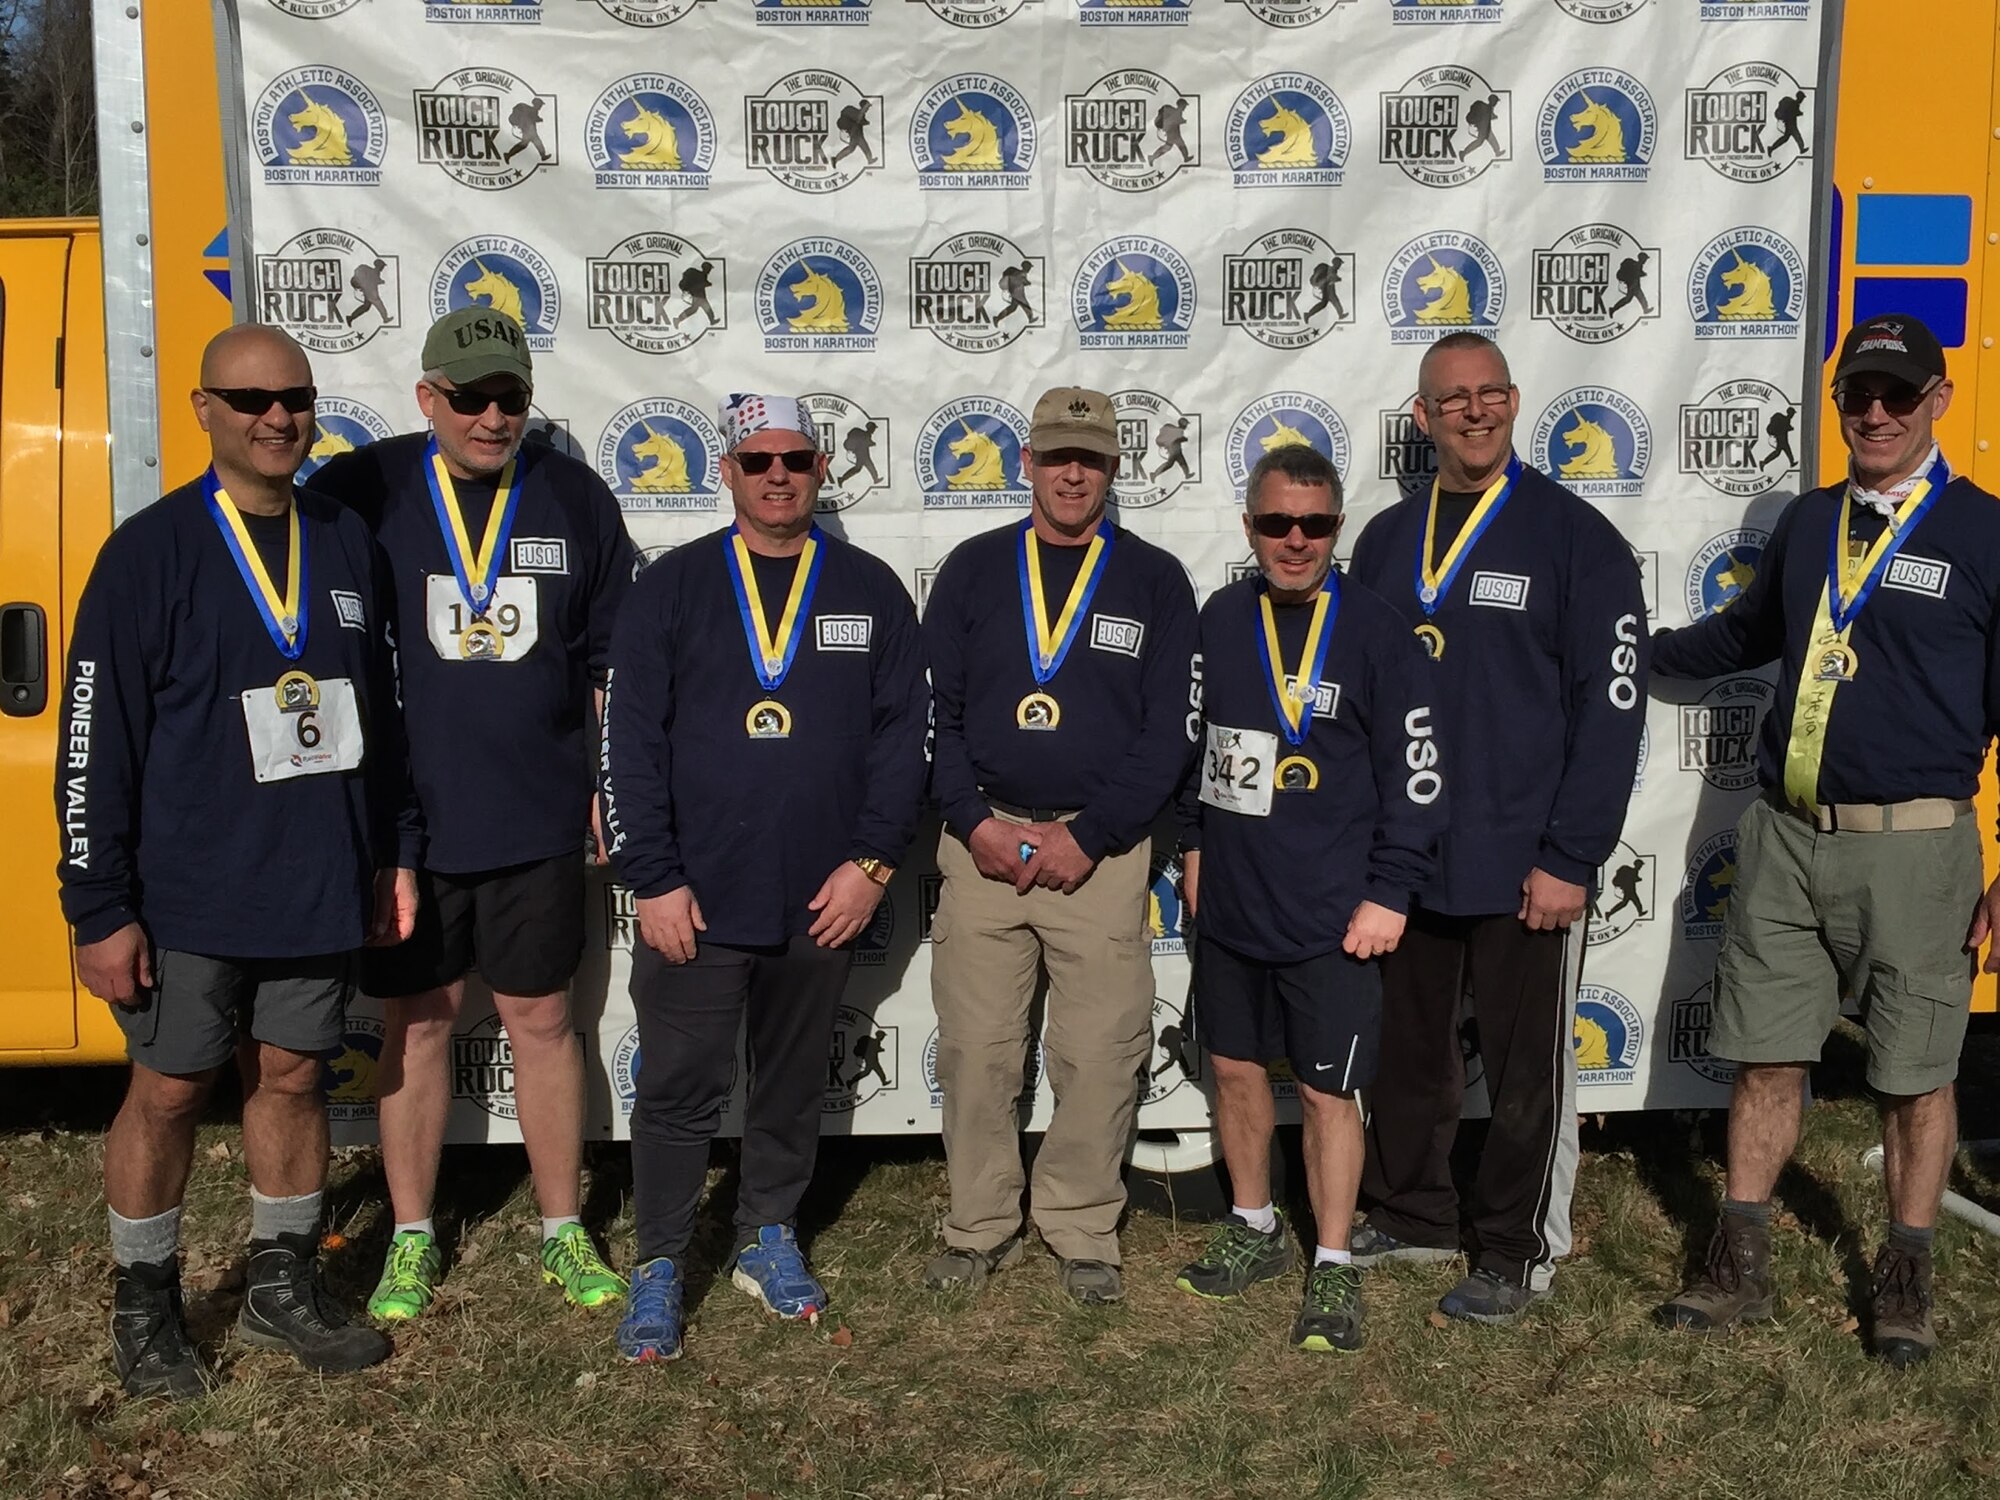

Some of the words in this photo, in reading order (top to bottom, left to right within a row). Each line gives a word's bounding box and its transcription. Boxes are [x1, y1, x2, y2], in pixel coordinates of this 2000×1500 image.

[290, 4, 319, 14] RUCK
[322, 4, 336, 14] ON
[426, 7, 471, 19] BOSTON
[476, 8, 541, 20] MARATHON
[757, 11, 801, 21] BOSTON
[806, 11, 869, 21] MARATHON
[1081, 11, 1124, 22] BOSTON
[1128, 11, 1189, 22] MARATHON
[1269, 14, 1296, 24] RUCK
[1299, 13, 1311, 23] ON
[1393, 10, 1436, 20] BOSTON
[1441, 9, 1501, 20] MARATHON
[1701, 6, 1744, 17] BOSTON
[1748, 6, 1809, 16] MARATHON
[453, 73, 472, 88] THE
[475, 70, 512, 90] ORIGINAL
[1104, 76, 1121, 92] THE
[1124, 74, 1160, 92] ORIGINAL
[1725, 69, 1742, 84] THE
[1746, 66, 1780, 84] ORIGINAL
[258, 102, 274, 156] BOSTON
[269, 70, 333, 102] ATHLETIC
[336, 75, 382, 158] ASSOCIATION
[422, 97, 499, 127] TOUGH
[590, 110, 606, 162] BOSTON
[602, 78, 664, 109] ATHLETIC
[667, 83, 712, 163] ASSOCIATION
[752, 103, 826, 131] TOUGH
[914, 110, 931, 163] BOSTON
[927, 78, 987, 110] ATHLETIC
[990, 82, 1032, 163] ASSOCIATION
[1072, 102, 1145, 130] TOUGH
[1230, 110, 1246, 161] BOSTON
[1242, 77, 1302, 109] ATHLETIC
[1304, 81, 1346, 159] ASSOCIATION
[1386, 98, 1458, 126] TOUGH
[1541, 104, 1557, 156] BOSTON
[1554, 71, 1612, 103] ATHLETIC
[1614, 76, 1654, 155] ASSOCIATION
[1693, 94, 1765, 122] TOUGH
[422, 128, 502, 160] RUCK
[752, 134, 829, 164] RUCK
[1071, 133, 1146, 163] RUCK
[1384, 129, 1459, 159] RUCK
[1691, 125, 1766, 154] RUCK
[264, 169, 310, 180] BOSTON
[315, 170, 380, 182] MARATHON
[467, 175, 495, 185] RUCK
[499, 175, 512, 185] ON
[920, 175, 963, 186] BOSTON
[968, 175, 1029, 186] MARATHON
[1235, 173, 1277, 183] BOSTON
[1282, 172, 1343, 183] MARATHON
[1424, 174, 1450, 183] RUCK
[1453, 172, 1465, 182] ON
[1545, 168, 1586, 178] BOSTON
[1591, 168, 1650, 178] MARATHON
[295, 235, 314, 251] THE
[317, 233, 354, 252] ORIGINAL
[948, 239, 965, 254] THE
[968, 236, 1004, 254] ORIGINAL
[264, 262, 341, 290] TOUGH
[435, 272, 451, 315] OSTON
[446, 239, 508, 271] ATHLETIC
[510, 244, 556, 325] ASSOCIATION
[594, 265, 668, 292] TOUGH
[760, 274, 776, 326] BOSTON
[772, 241, 833, 273] ATHLETIC
[835, 245, 878, 325] ASSOCIATION
[916, 264, 989, 292] TOUGH
[1076, 272, 1092, 323] BOSTON
[1088, 240, 1148, 271] ATHLETIC
[1150, 244, 1192, 322] ASSOCIATION
[1230, 261, 1301, 289] TOUGH
[1387, 267, 1403, 318] BOSTON
[1399, 235, 1459, 266] ATHLETIC
[1461, 239, 1502, 316] ASSOCIATION
[1539, 256, 1608, 283] TOUGH
[1693, 262, 1709, 313] BOSTON
[1705, 230, 1763, 262] ATHLETIC
[1765, 234, 1803, 312] ASSOCIATION
[264, 293, 344, 323] RUCK
[593, 295, 671, 325] RUCK
[915, 295, 991, 324] RUCK
[1228, 291, 1302, 321] RUCK
[1536, 286, 1609, 315] RUCK
[637, 340, 664, 349] RUCK
[667, 339, 681, 349] ON
[765, 338, 809, 348] BOSTON
[814, 338, 875, 348] MARATHON
[1392, 329, 1434, 340] BOSTON
[1696, 325, 1736, 335] BOSTON
[1741, 325, 1798, 335] MARATHON
[1125, 394, 1161, 412] ORIGINAL
[1717, 386, 1734, 401] THE
[1737, 383, 1772, 401] ORIGINAL
[812, 398, 848, 416] ORIGINAL
[1230, 428, 1246, 478] BOSTON
[1242, 396, 1302, 427] ATHLETIC
[1304, 399, 1346, 476] ASSOCIATION
[1535, 422, 1550, 472] BOSTON
[1547, 390, 1605, 421] ATHLETIC
[1607, 394, 1646, 470] ASSOCIATION
[1686, 410, 1757, 438] TOUGH
[602, 434, 618, 485] BOSTON
[614, 402, 674, 433] ATHLETIC
[677, 406, 720, 485] ASSOCIATION
[920, 432, 936, 483] BOSTON
[932, 400, 992, 431] ATHLETIC
[1685, 440, 1758, 469] RUCK
[1385, 446, 1438, 475] RUC
[924, 495, 967, 505] BOSTON
[972, 494, 1032, 504] MARATHON
[1144, 493, 1157, 503] ON
[1584, 482, 1642, 493] MARATHON
[1724, 483, 1750, 492] RUCK
[1753, 482, 1765, 491] ON
[621, 498, 651, 508] STON
[656, 497, 718, 507] MARATHON
[525, 546, 554, 565] USO
[1689, 564, 1704, 614] BOSTON
[1701, 533, 1757, 564] ATHLETIC
[1898, 562, 1933, 586] USO
[1483, 579, 1515, 599] USO
[830, 623, 859, 642] USO
[1608, 613, 1637, 710] USO
[1186, 653, 1203, 743] USO
[68, 661, 96, 769] PIONEER
[1685, 708, 1754, 735] TOUGH
[297, 712, 320, 748] 6
[1404, 706, 1442, 805] USO
[1685, 737, 1752, 766] RUCK
[1208, 750, 1260, 790] 342
[66, 776, 90, 870] VALLEY
[1695, 833, 1734, 867] ATHLET
[1152, 940, 1190, 952] ATHON
[1602, 992, 1639, 1061] ASSOCIATION
[456, 1040, 512, 1064] TOUG
[456, 1067, 515, 1094] RUC
[617, 1042, 634, 1092] BOSTON
[1577, 1071, 1634, 1083] MARATHON
